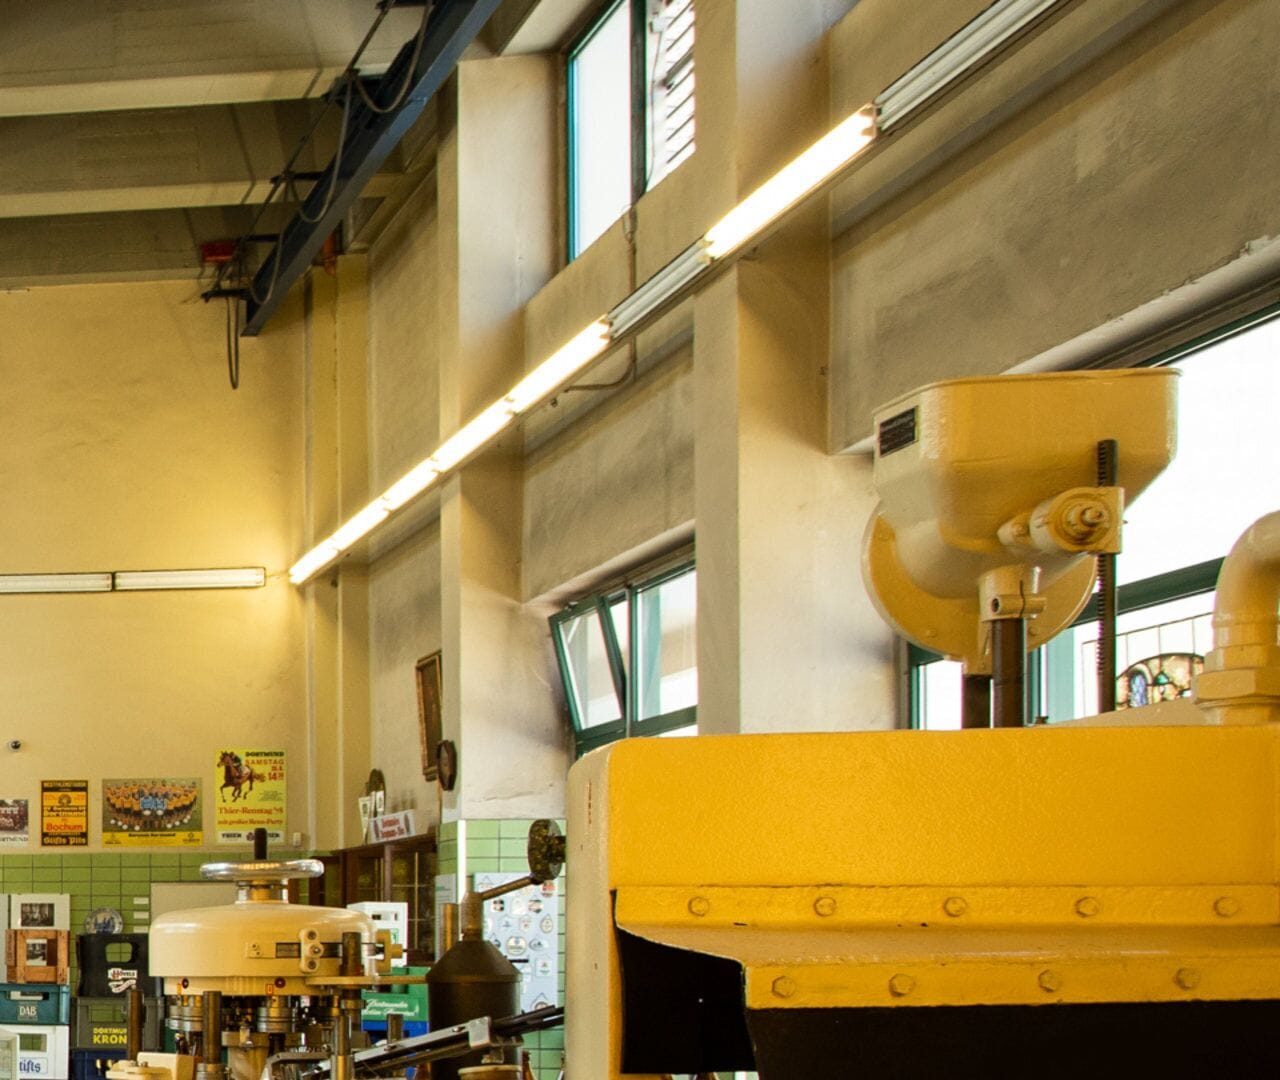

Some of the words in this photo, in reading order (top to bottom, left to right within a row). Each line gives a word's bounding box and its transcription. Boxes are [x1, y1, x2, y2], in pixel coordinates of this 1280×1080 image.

[46, 823, 83, 831] Bochum
[20, 1006, 37, 1016] DAB
[93, 1035, 127, 1044] KRON
[19, 1059, 41, 1073] tifts
